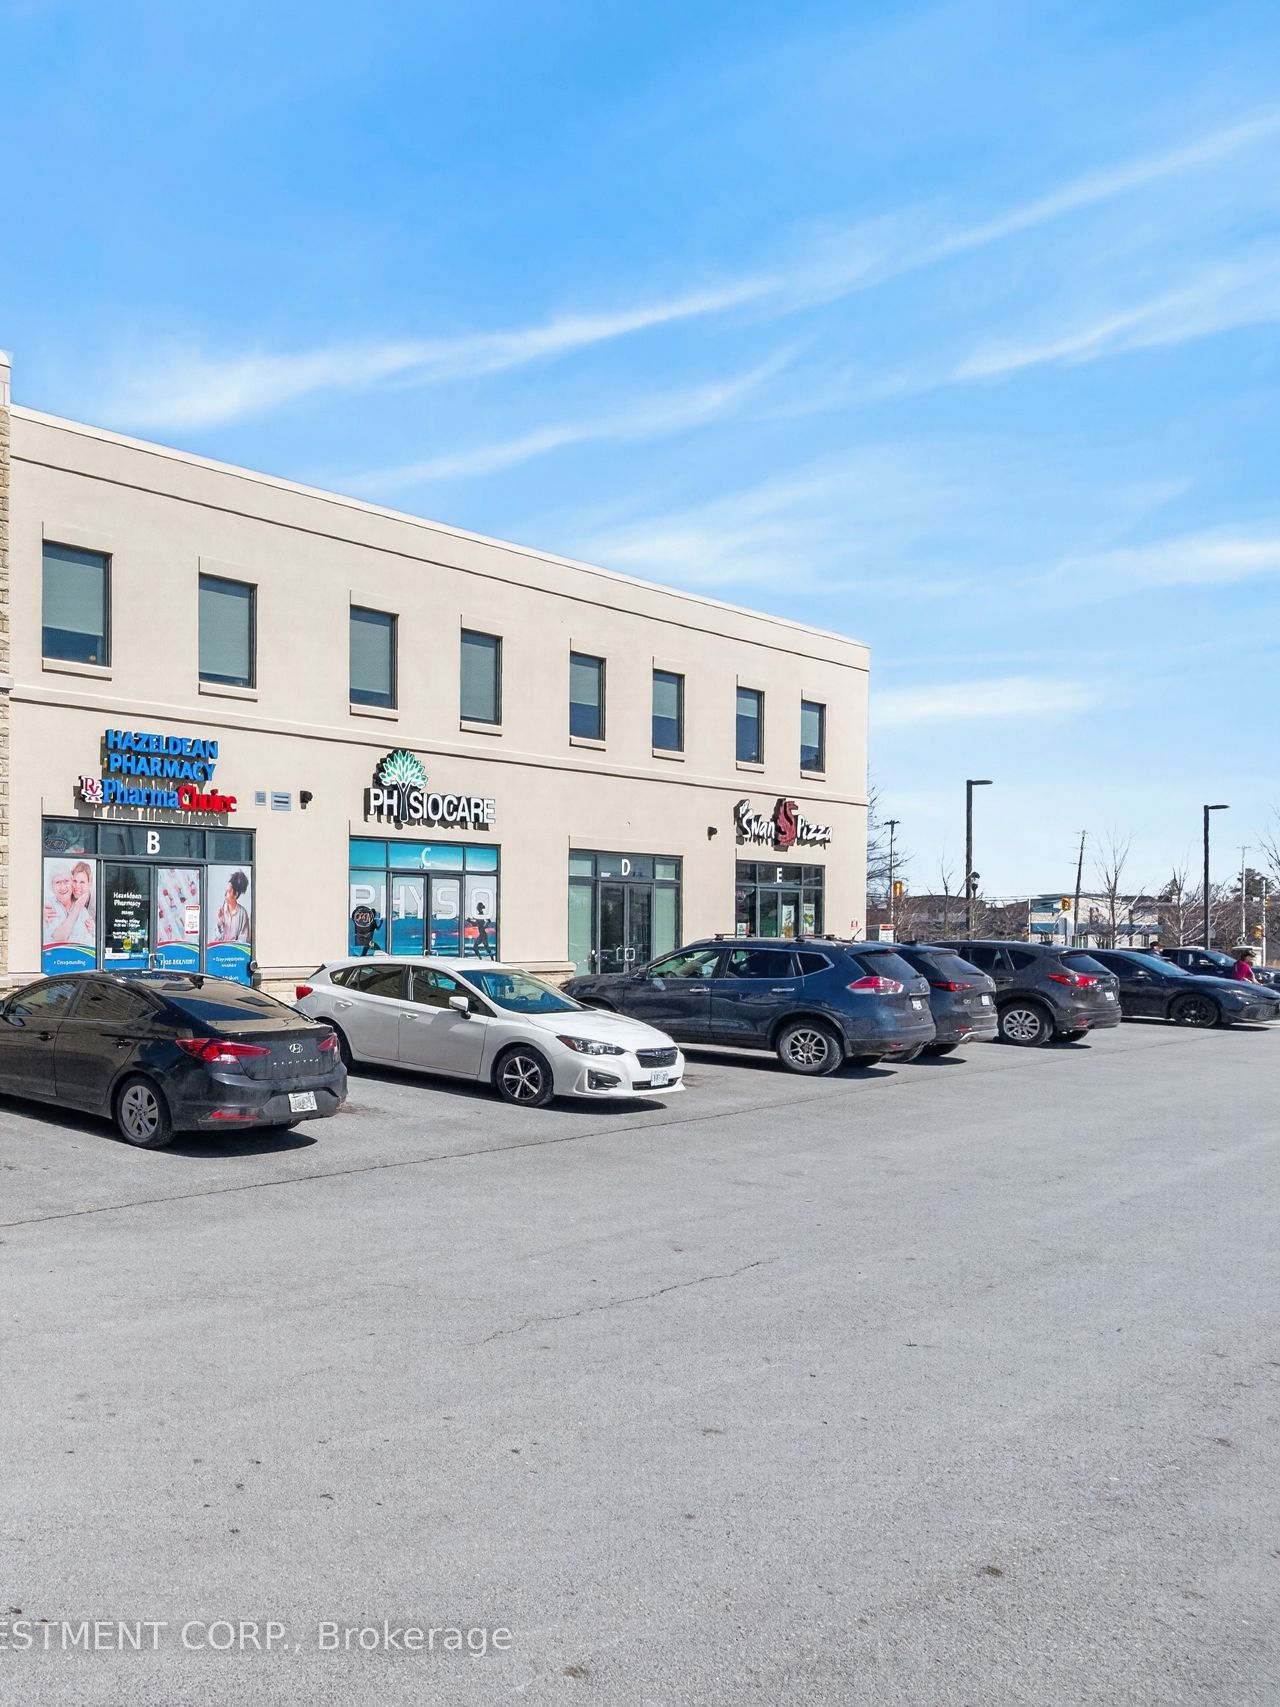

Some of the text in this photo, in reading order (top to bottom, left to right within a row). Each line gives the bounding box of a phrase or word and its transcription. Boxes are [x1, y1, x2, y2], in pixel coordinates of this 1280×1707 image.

[106, 729, 218, 759] HAZELDEAN
[109, 753, 216, 782] PHARMACY
[369, 788, 496, 824] PHYSIOCARE
[742, 809, 833, 841] Swan Pizza
[146, 831, 160, 854] B
[421, 848, 432, 866] C
[621, 858, 631, 876] D
[776, 867, 783, 883] E
